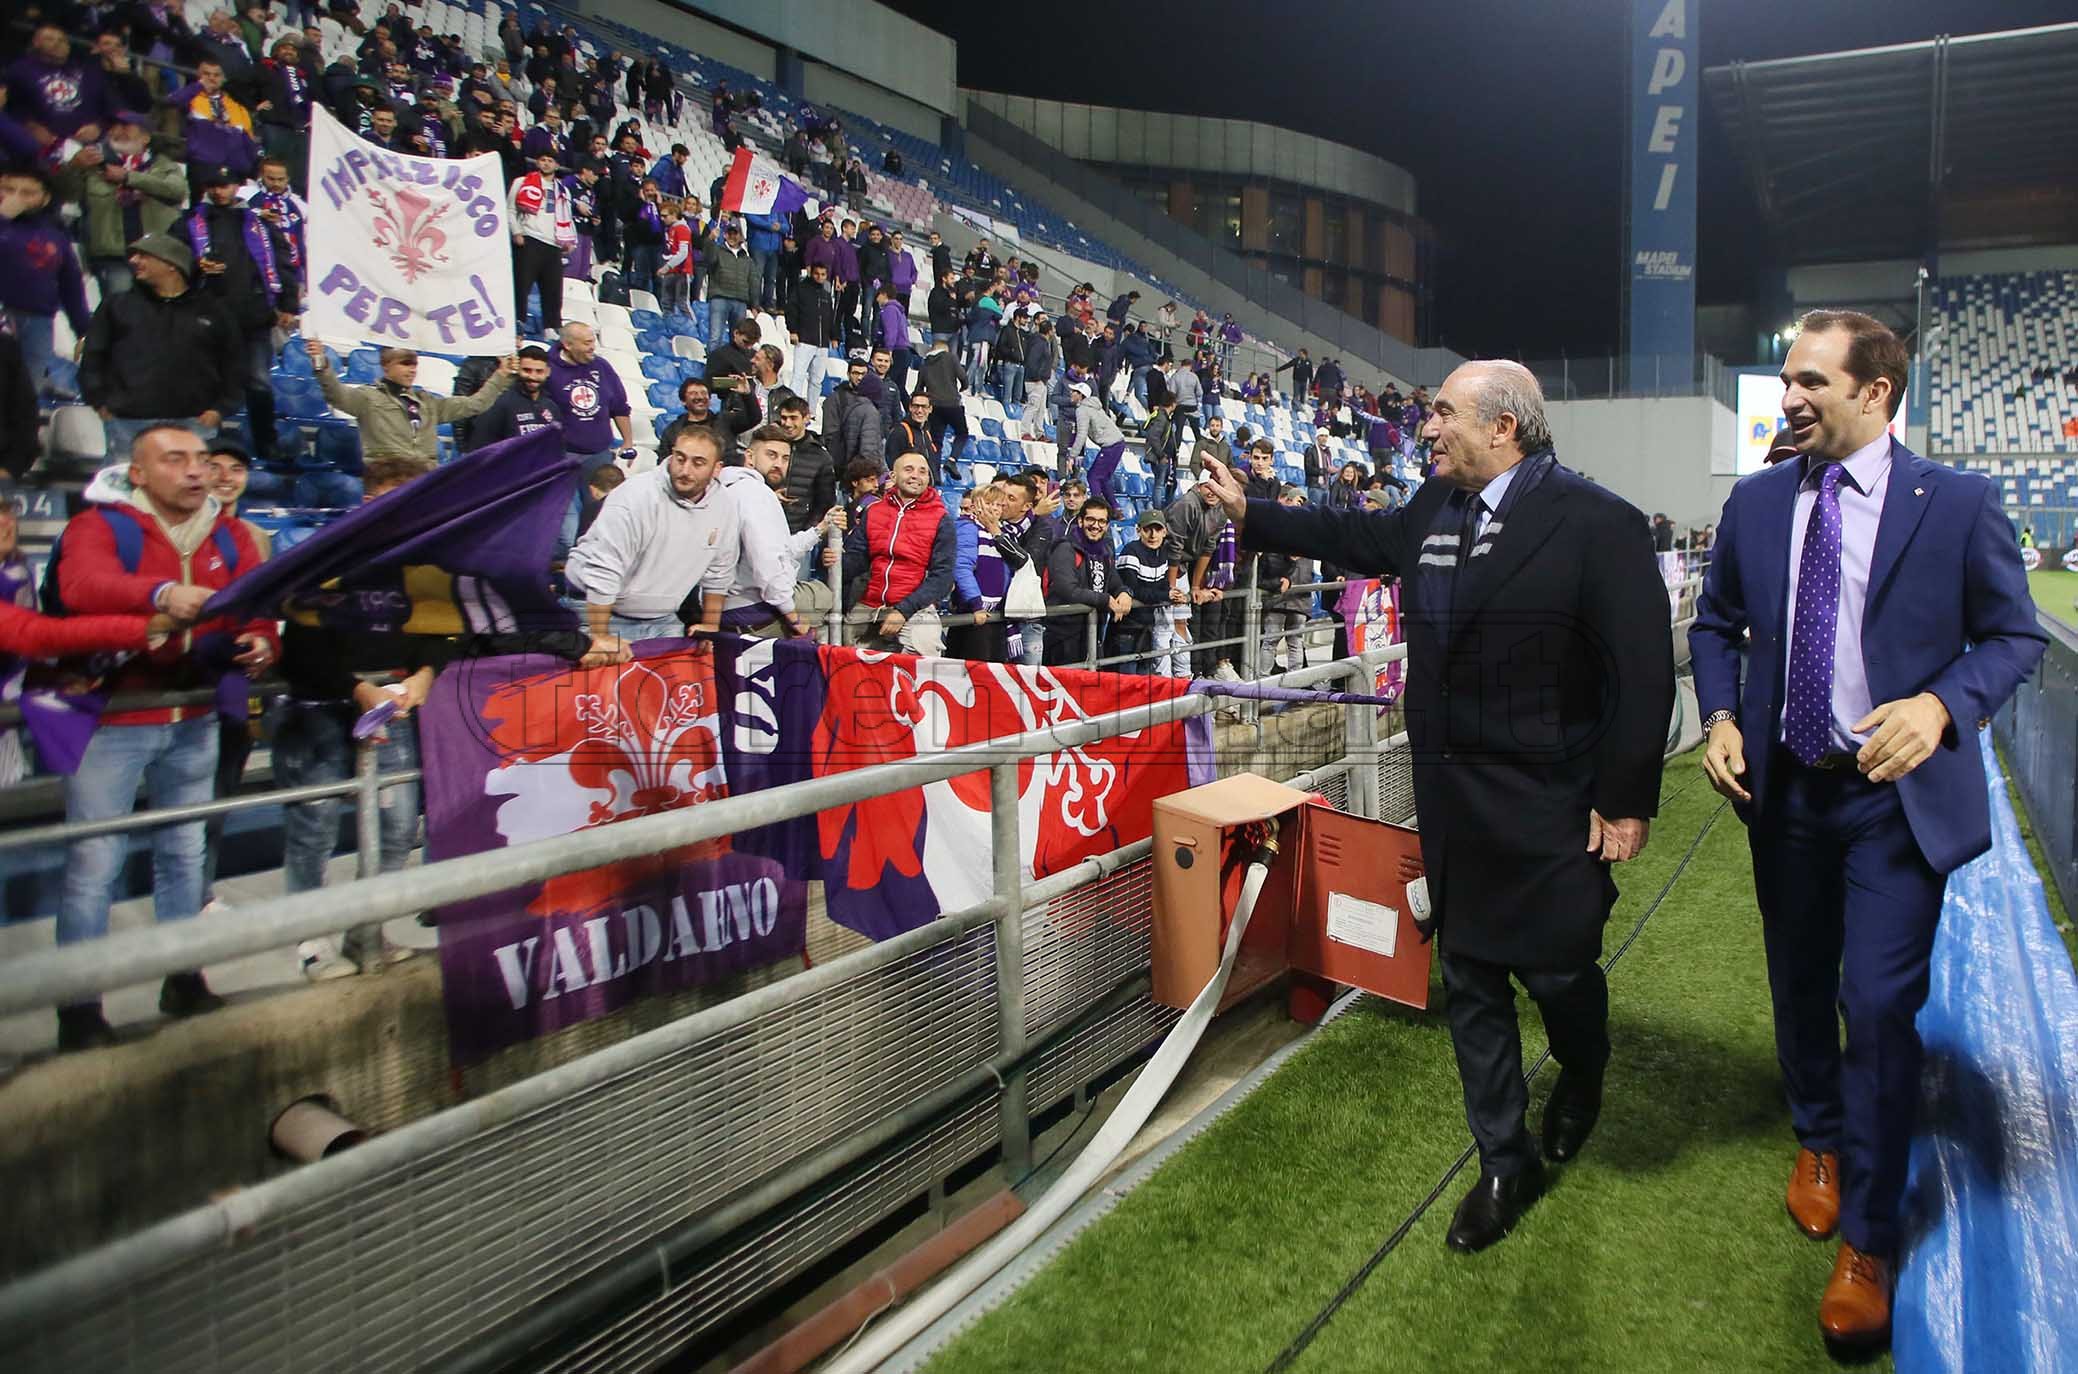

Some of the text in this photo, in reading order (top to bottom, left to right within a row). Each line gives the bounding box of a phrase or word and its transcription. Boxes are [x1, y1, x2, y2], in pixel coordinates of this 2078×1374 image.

[321, 149, 499, 237] IMPAZZISCO
[1635, 251, 1678, 264] MAPEI
[319, 264, 505, 344] PER TE!
